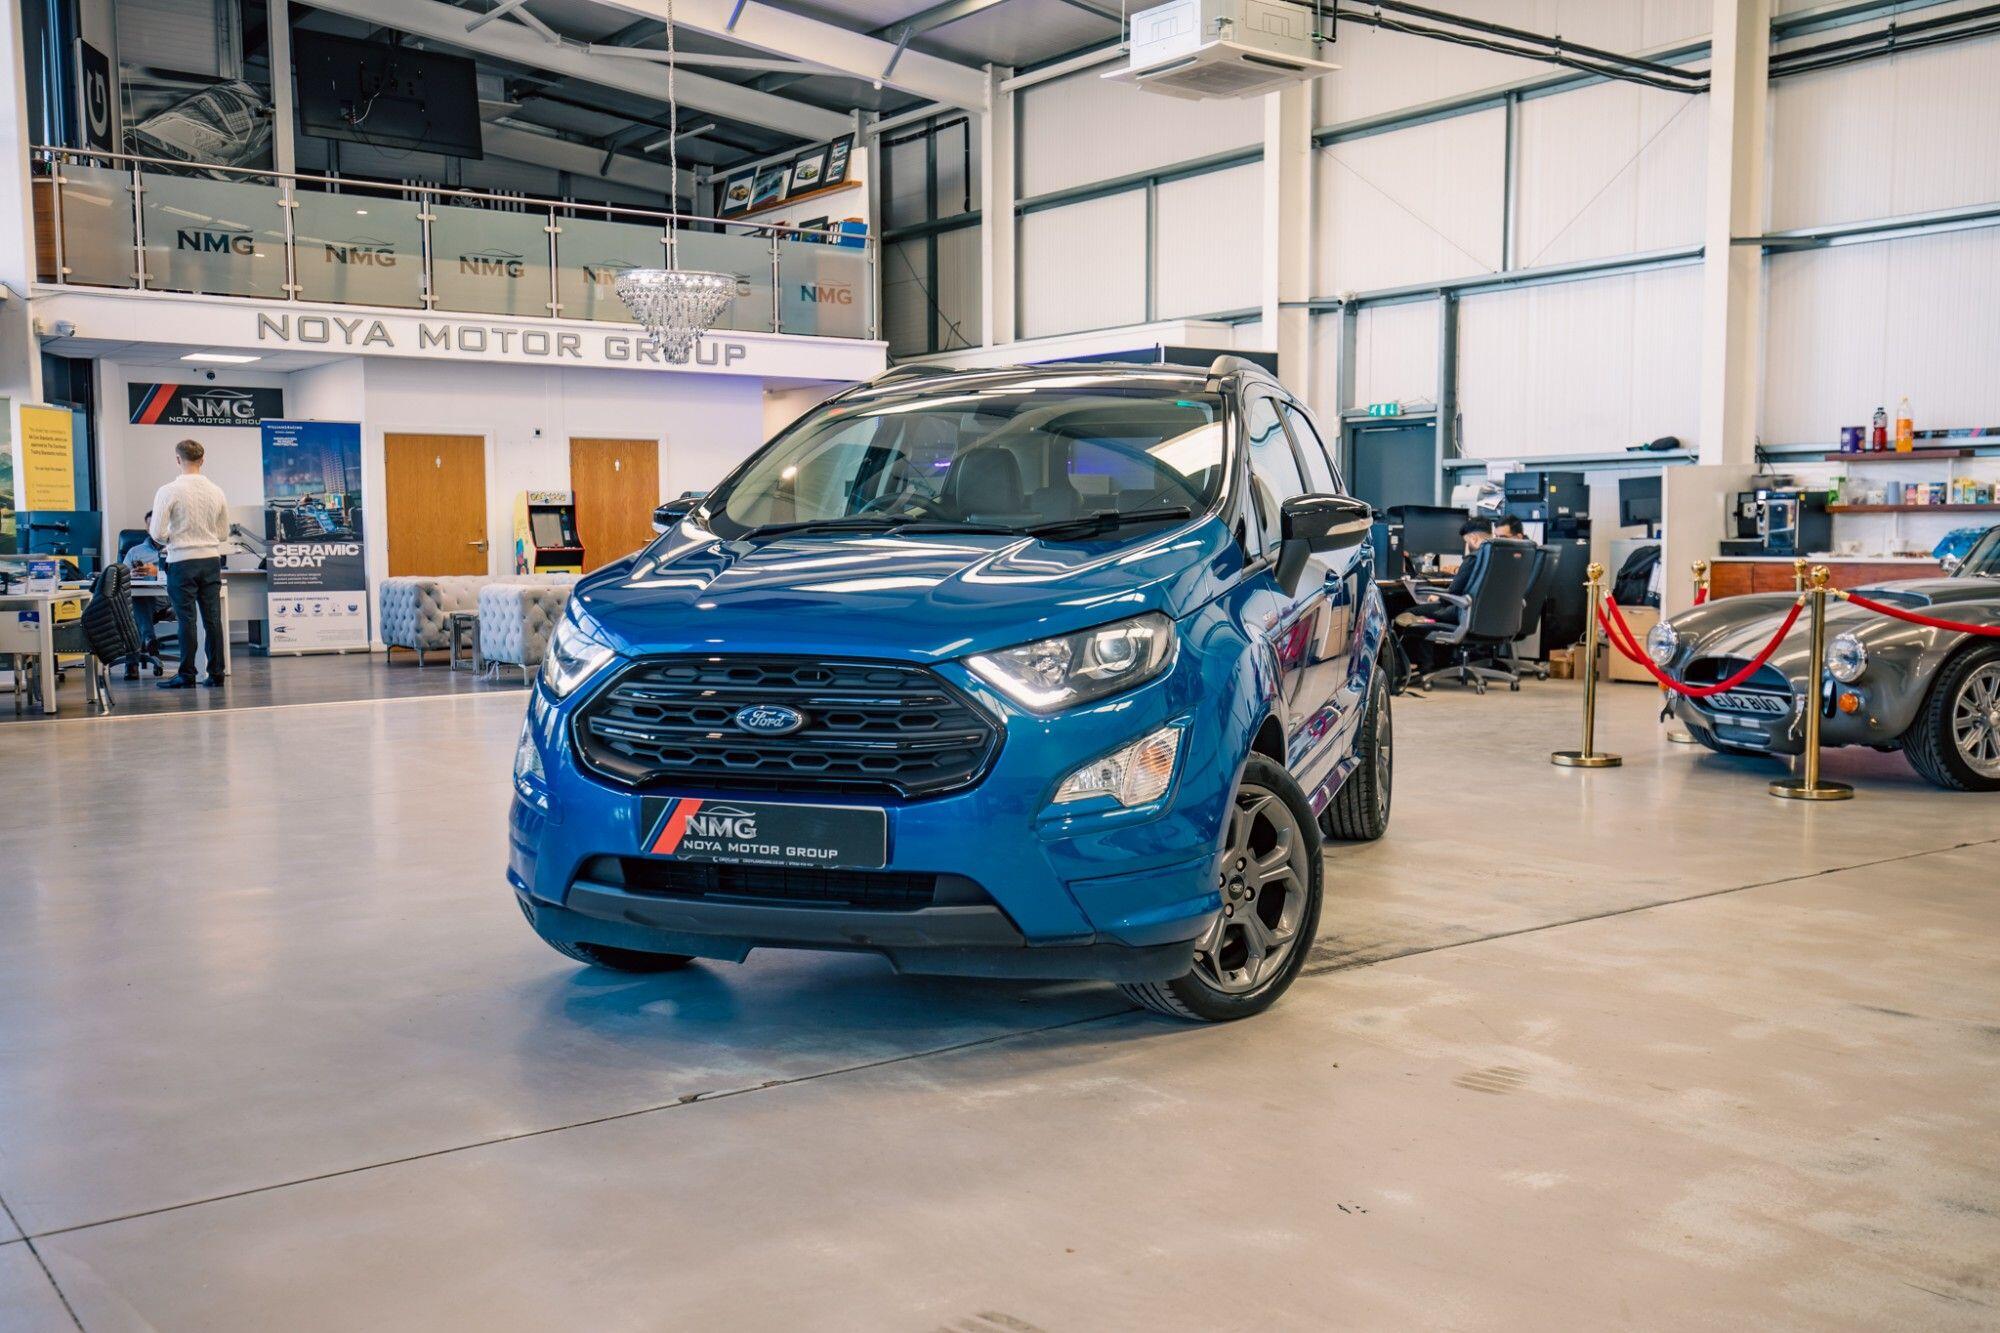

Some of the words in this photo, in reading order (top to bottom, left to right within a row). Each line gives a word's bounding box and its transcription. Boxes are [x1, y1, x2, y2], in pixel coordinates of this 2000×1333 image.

[177, 230, 255, 255] NMG
[325, 243, 397, 267] NMG
[459, 256, 525, 278] NMG
[800, 285, 852, 305] NMG
[258, 312, 395, 347] NOYA
[419, 323, 583, 359] MOTOR
[604, 335, 746, 367] GRUP
[181, 397, 256, 418] NMG
[272, 544, 360, 556] CERAMIC
[273, 556, 326, 568] COAT
[749, 709, 786, 729] Ford
[685, 814, 758, 839] NMG
[683, 840, 722, 851] NOYA
[728, 843, 780, 855] MOTOR
[786, 847, 839, 859] GROUP
